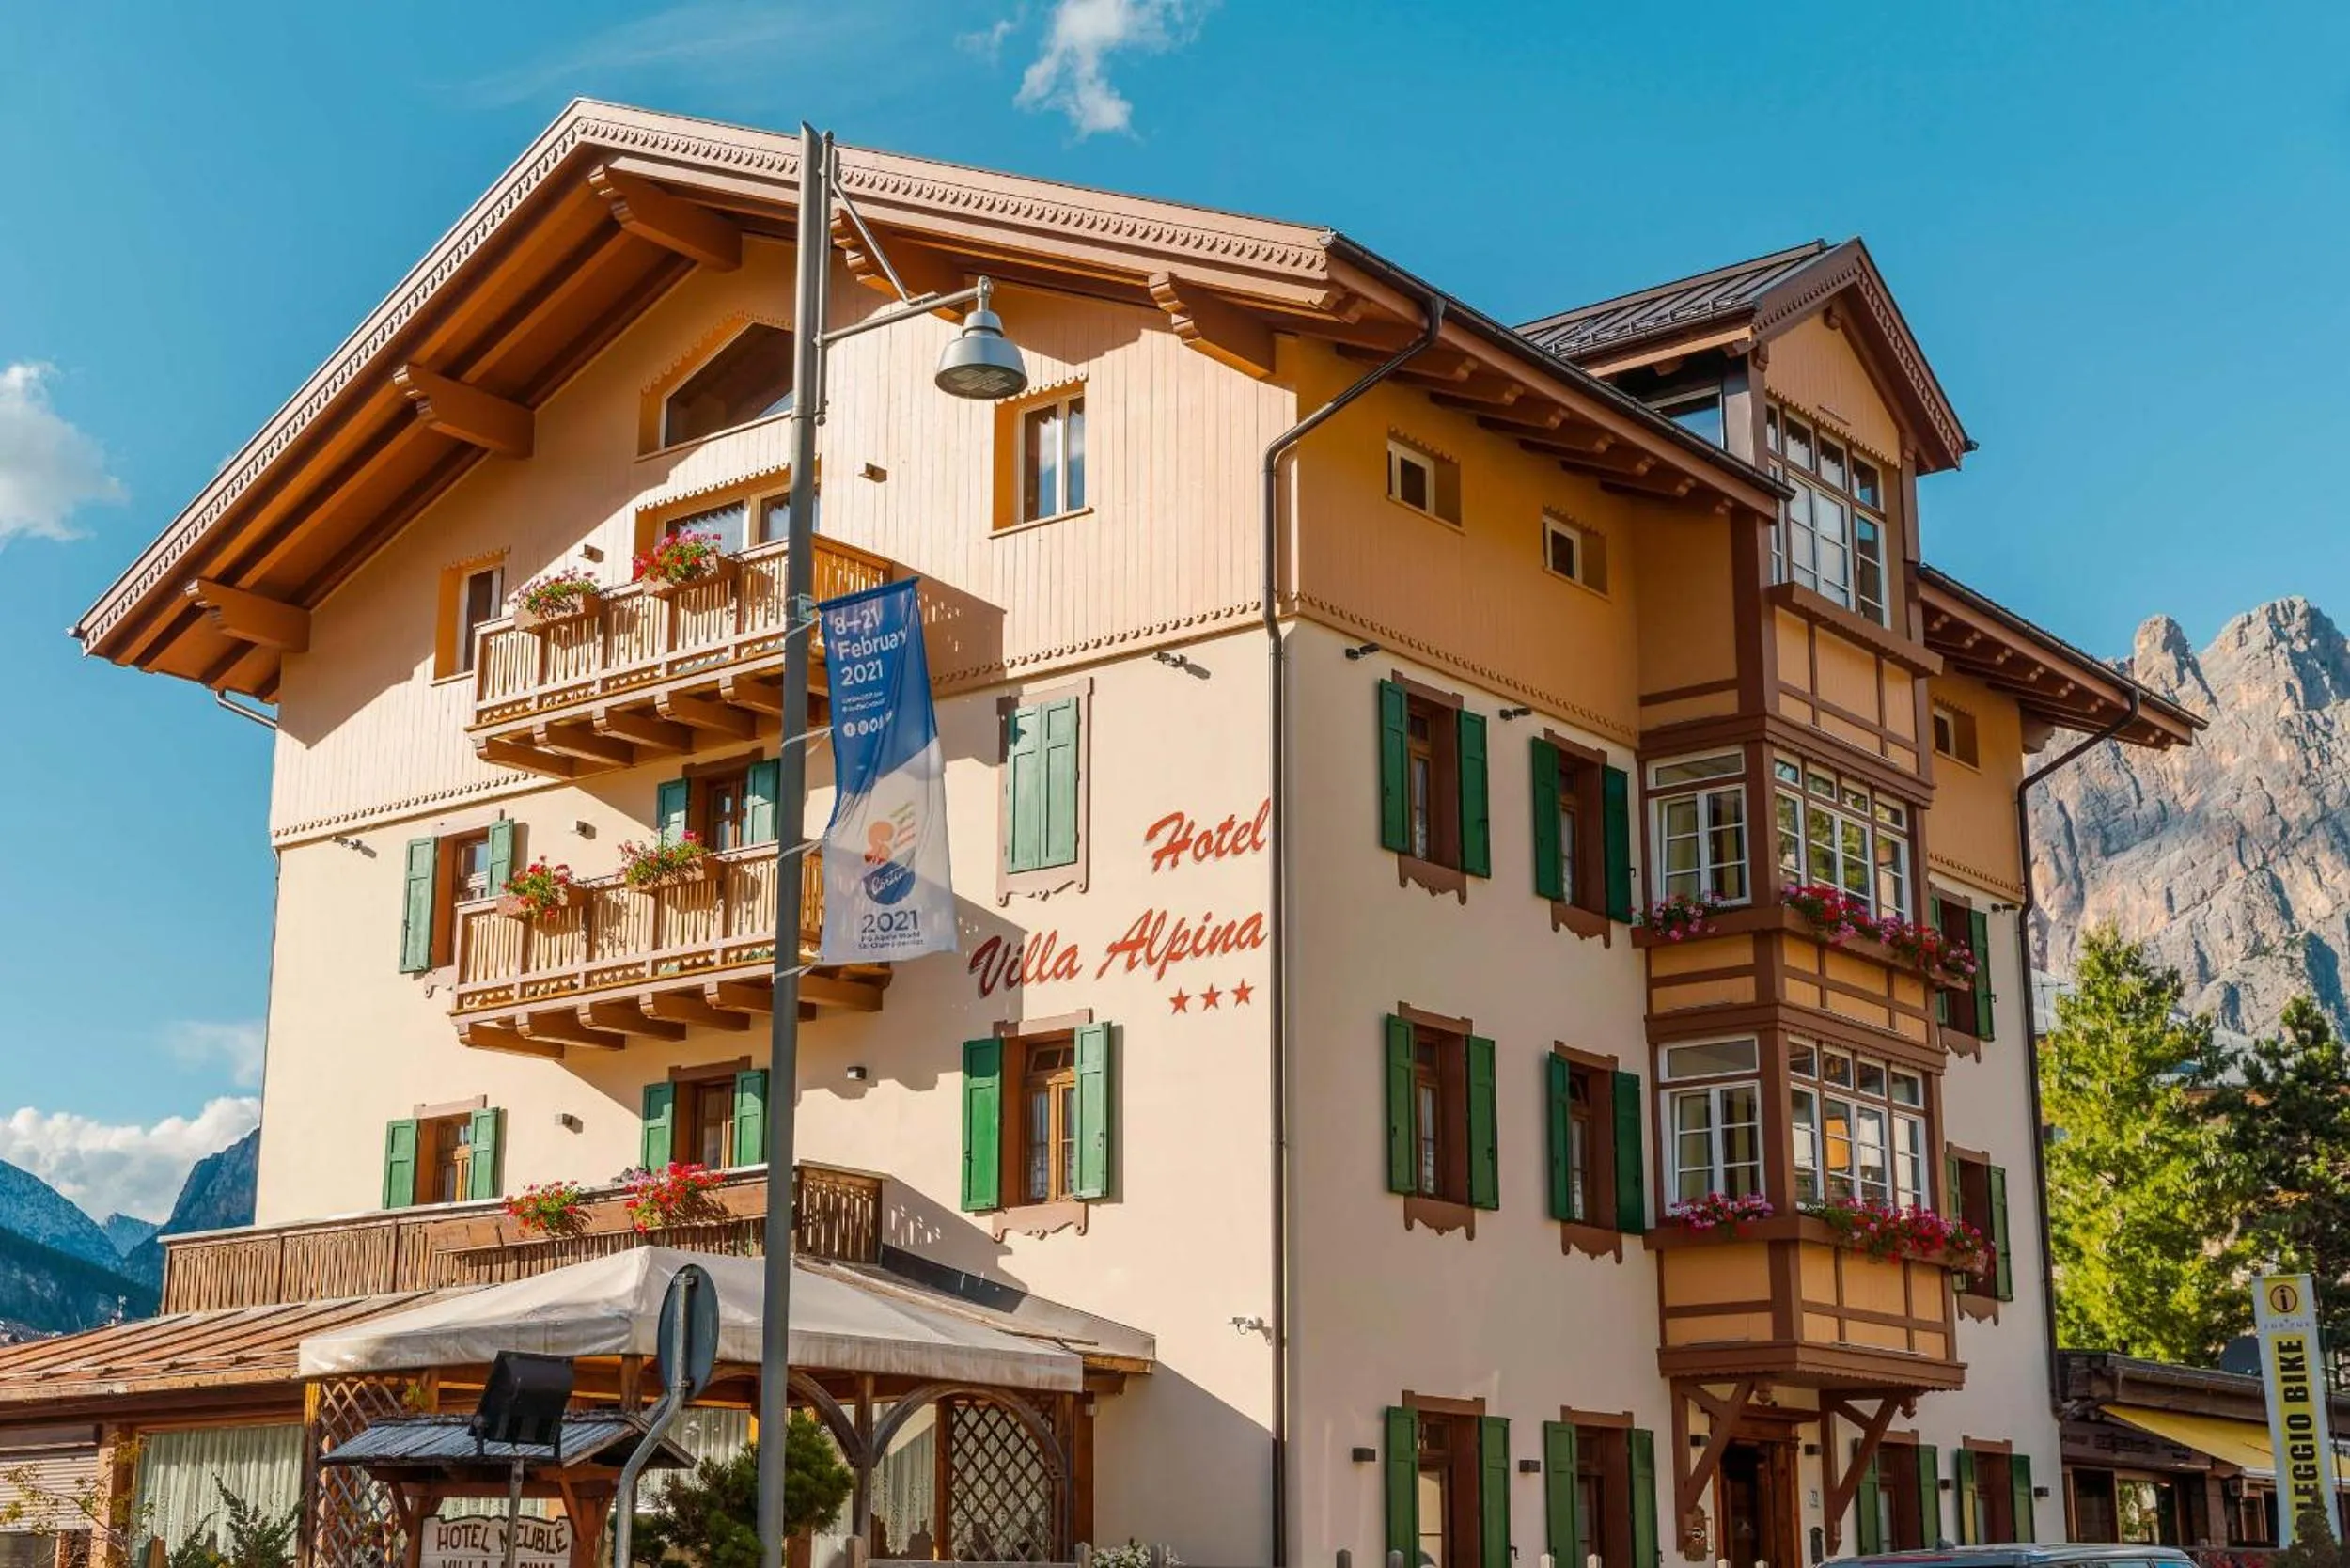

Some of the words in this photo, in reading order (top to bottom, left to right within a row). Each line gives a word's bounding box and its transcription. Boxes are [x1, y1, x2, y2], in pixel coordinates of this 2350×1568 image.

[838, 625, 908, 662] Februay
[840, 659, 884, 686] 2021
[1144, 797, 1271, 873] Hotel
[861, 909, 918, 933] 2021
[967, 929, 1083, 998] Villa
[1094, 908, 1268, 981] Alpina
[2277, 1340, 2309, 1402] BIKE
[437, 1524, 491, 1553] HOTEL
